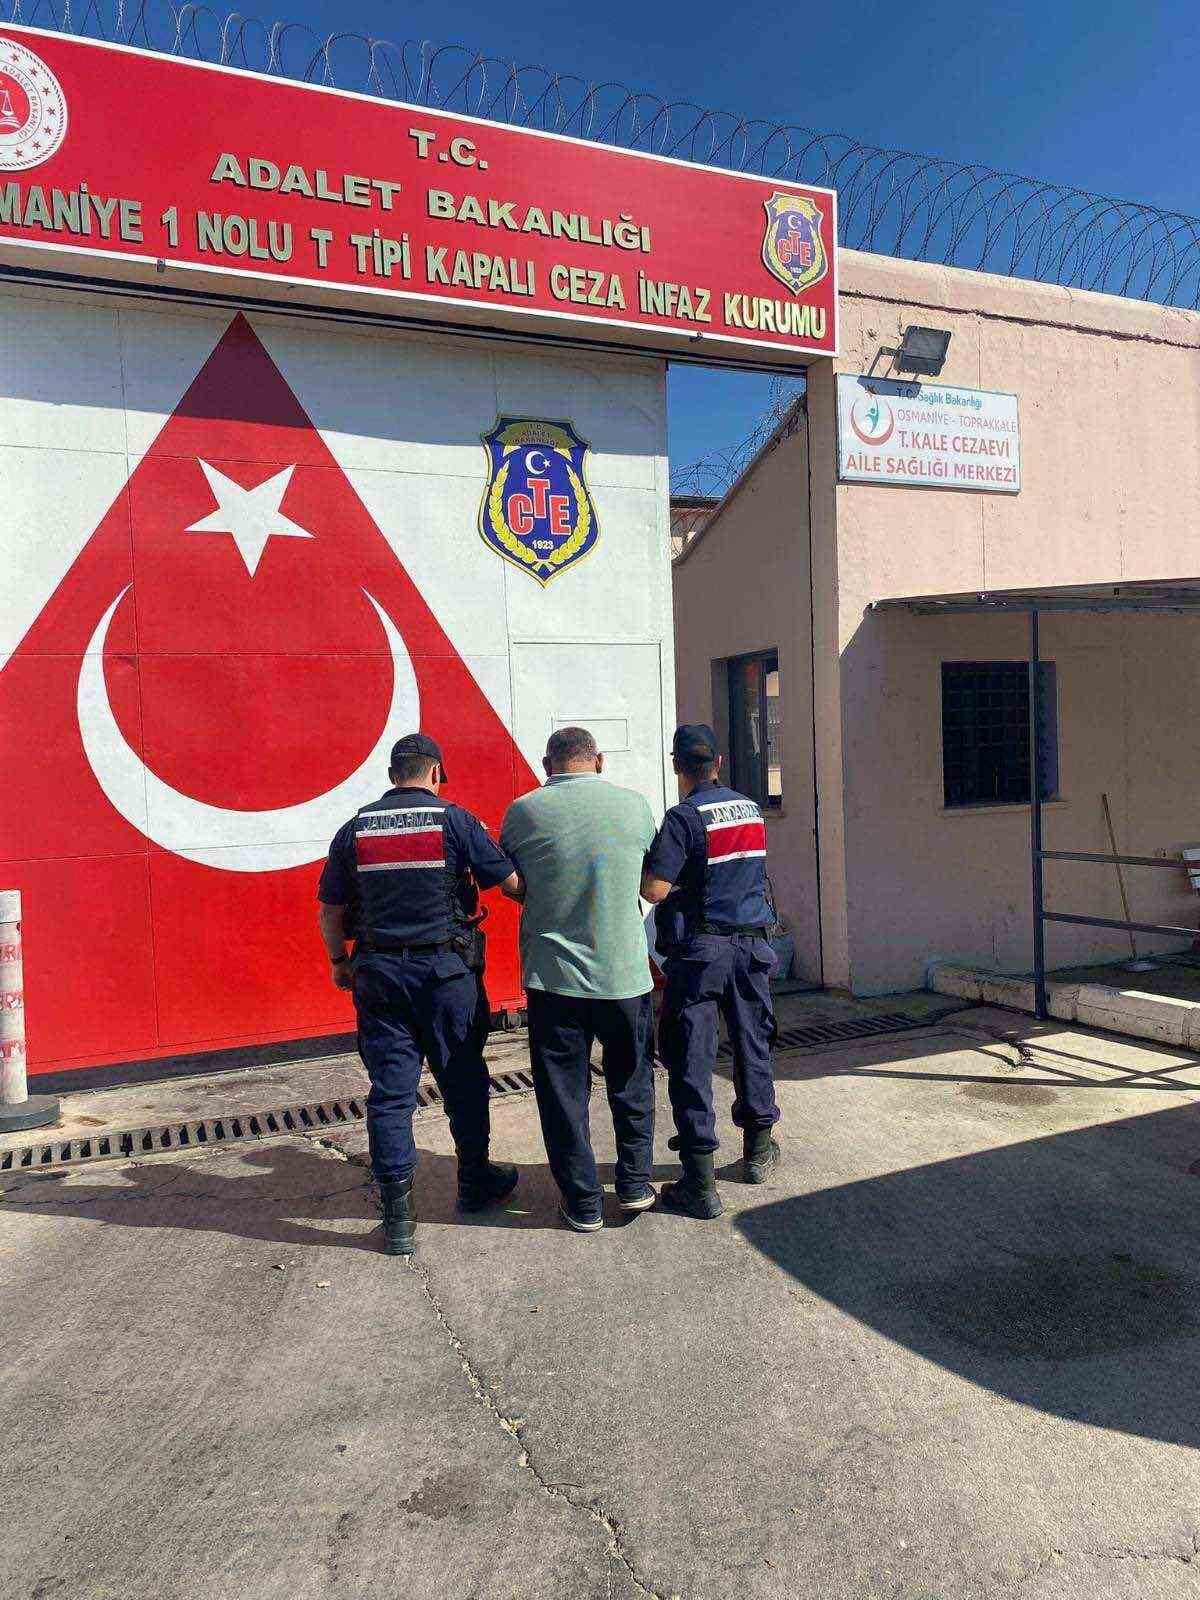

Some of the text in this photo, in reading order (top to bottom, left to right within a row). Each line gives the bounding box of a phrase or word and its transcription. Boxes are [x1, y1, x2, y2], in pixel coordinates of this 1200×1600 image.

[409, 128, 489, 170] T.C.
[210, 153, 651, 253] ADALET BAKANLIĞI
[777, 231, 812, 267] CTE
[162, 206, 180, 247] 1
[197, 211, 293, 262] NOLU
[311, 228, 333, 269] T
[350, 229, 412, 280] TİPİ
[426, 245, 537, 297] KAPALI
[551, 263, 626, 311] CEZA
[639, 270, 712, 324] İNFAZ
[724, 293, 827, 339] KURUMU
[960, 415, 1017, 433] TOPRAKKALE
[899, 430, 1010, 458] T.KALE CEZAEVİ
[846, 452, 1017, 483] AİLE SAĞLIĞI MERKEZİ
[508, 478, 572, 536] CTE
[531, 540, 554, 551] 1923
[364, 811, 435, 831] JANDARMA
[712, 802, 760, 823] JANDARMA
